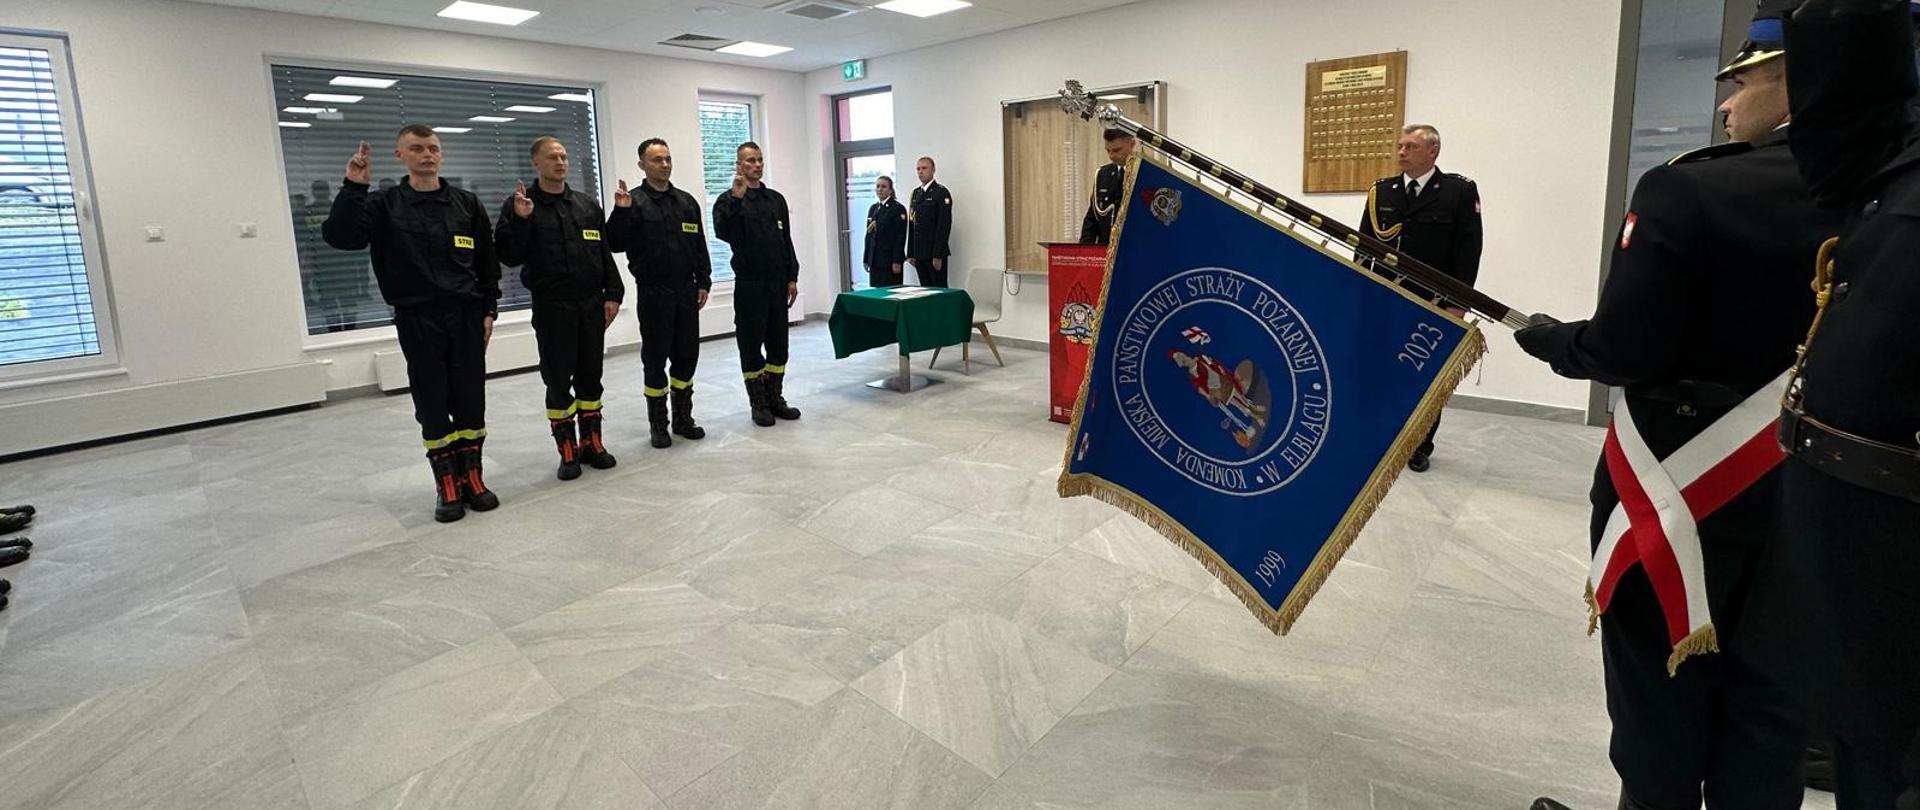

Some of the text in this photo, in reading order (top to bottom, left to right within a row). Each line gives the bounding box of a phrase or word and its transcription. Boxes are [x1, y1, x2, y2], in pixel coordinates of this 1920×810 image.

[1185, 273, 1246, 301] STRAŻY
[1117, 283, 1183, 384] PAŃSTWOWEJ
[1252, 291, 1320, 374] POŻARNEJ
[1397, 322, 1444, 372] 2023
[1124, 392, 1171, 450] MIEJSKA
[1175, 446, 1248, 489] KOMENDA
[1260, 460, 1281, 484] W
[1255, 549, 1286, 589] 1999
